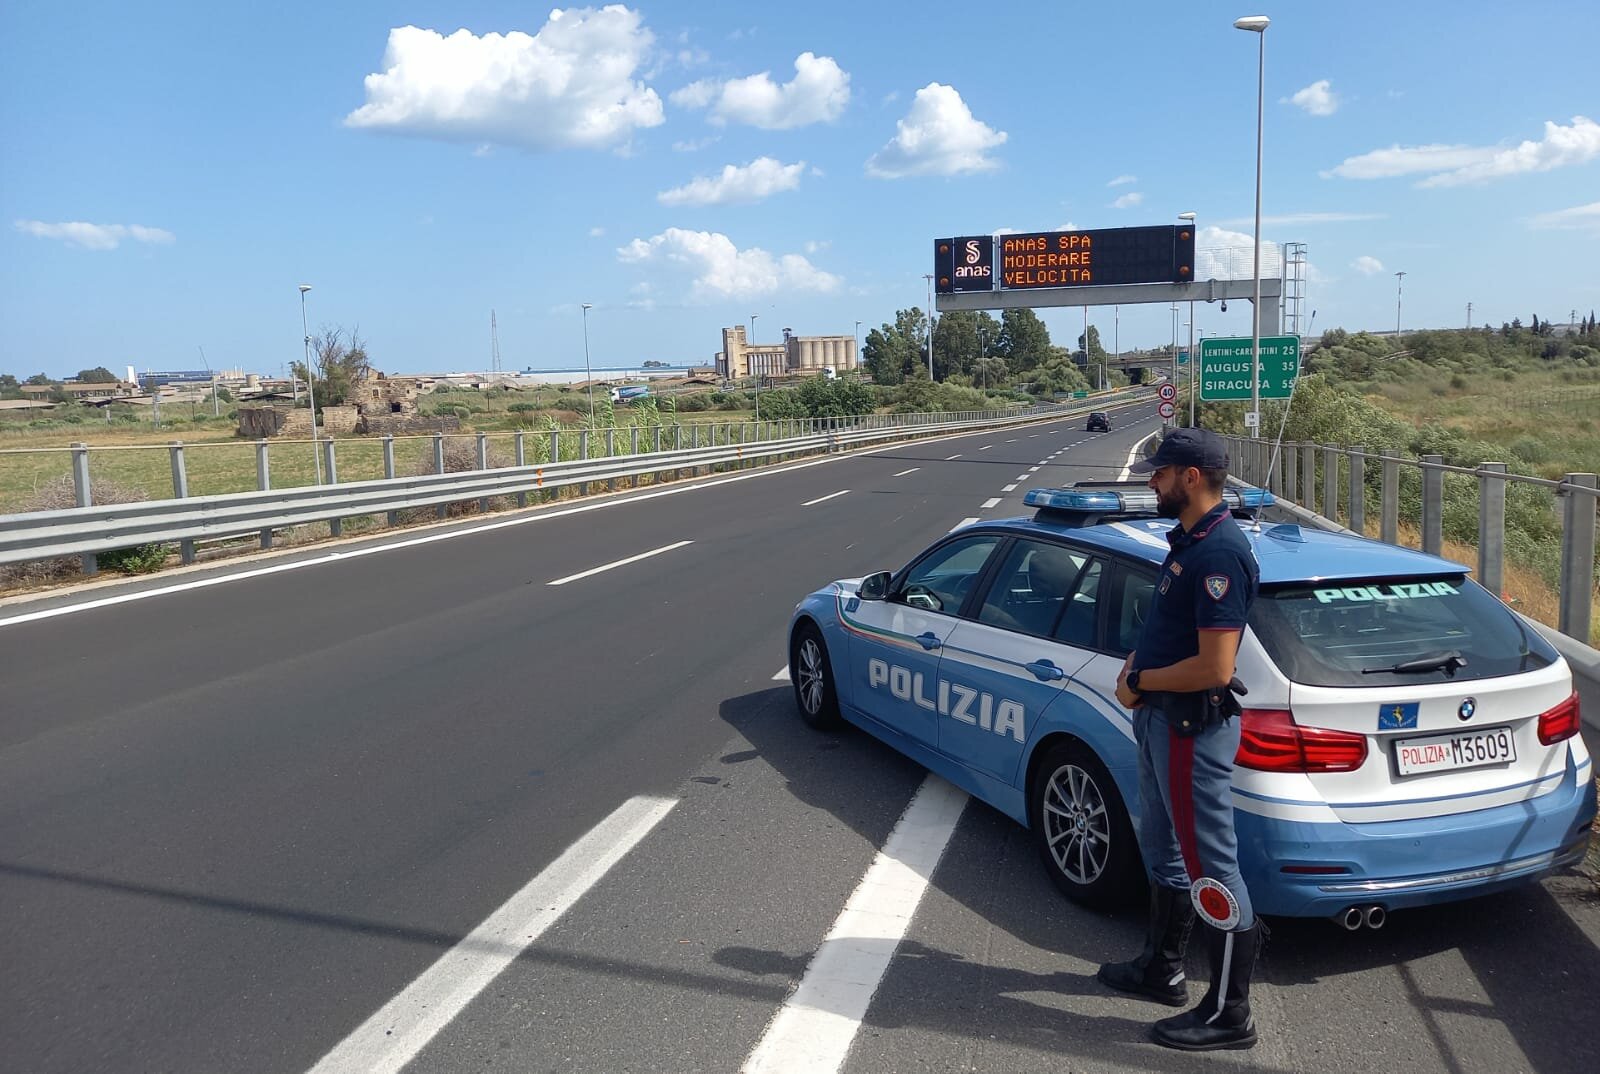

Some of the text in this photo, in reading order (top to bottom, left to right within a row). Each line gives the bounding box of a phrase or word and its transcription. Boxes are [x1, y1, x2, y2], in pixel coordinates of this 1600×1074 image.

[1005, 235, 1091, 252] ANAS SPA
[1005, 251, 1091, 268] MODERARE
[955, 264, 991, 277] anas
[1005, 268, 1091, 285] VELOCITA
[1204, 345, 1295, 357] LENTINI-CARLNTINI 25
[1281, 361, 1295, 372] 35
[1162, 388, 1173, 397] 40
[1281, 379, 1294, 389] 55
[1313, 581, 1460, 603] POLIZIA
[868, 657, 1026, 744] POLIZIA
[1402, 733, 1510, 766] POLIZIA M3609
